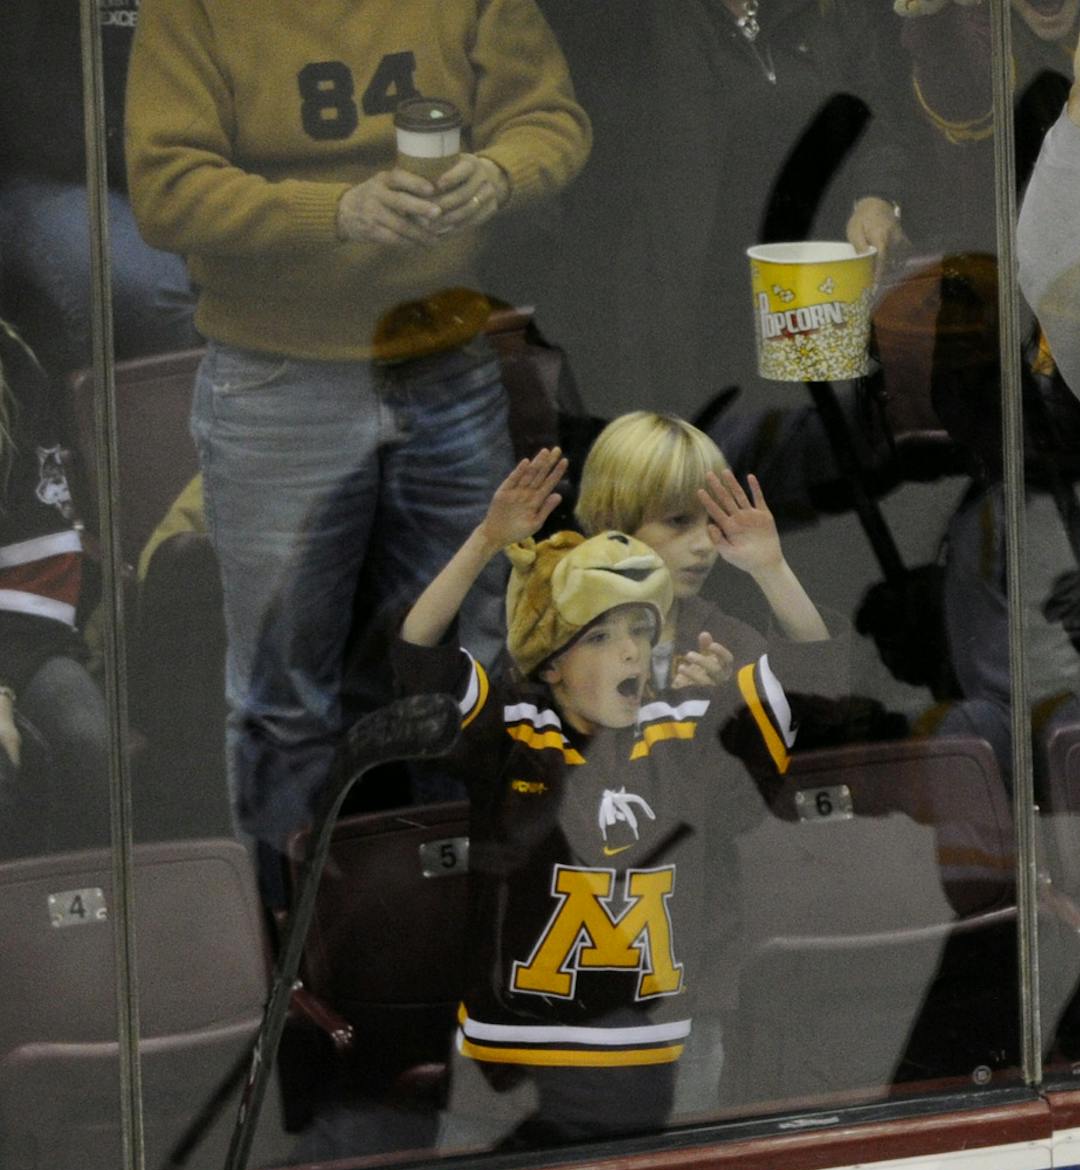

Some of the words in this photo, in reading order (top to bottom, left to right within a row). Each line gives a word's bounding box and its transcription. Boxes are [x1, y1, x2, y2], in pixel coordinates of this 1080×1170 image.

[298, 51, 423, 140] 84
[758, 292, 844, 340] POPCORN
[815, 791, 833, 816] 6
[440, 843, 457, 869] 5
[70, 894, 86, 919] 4
[510, 863, 684, 1002] M
